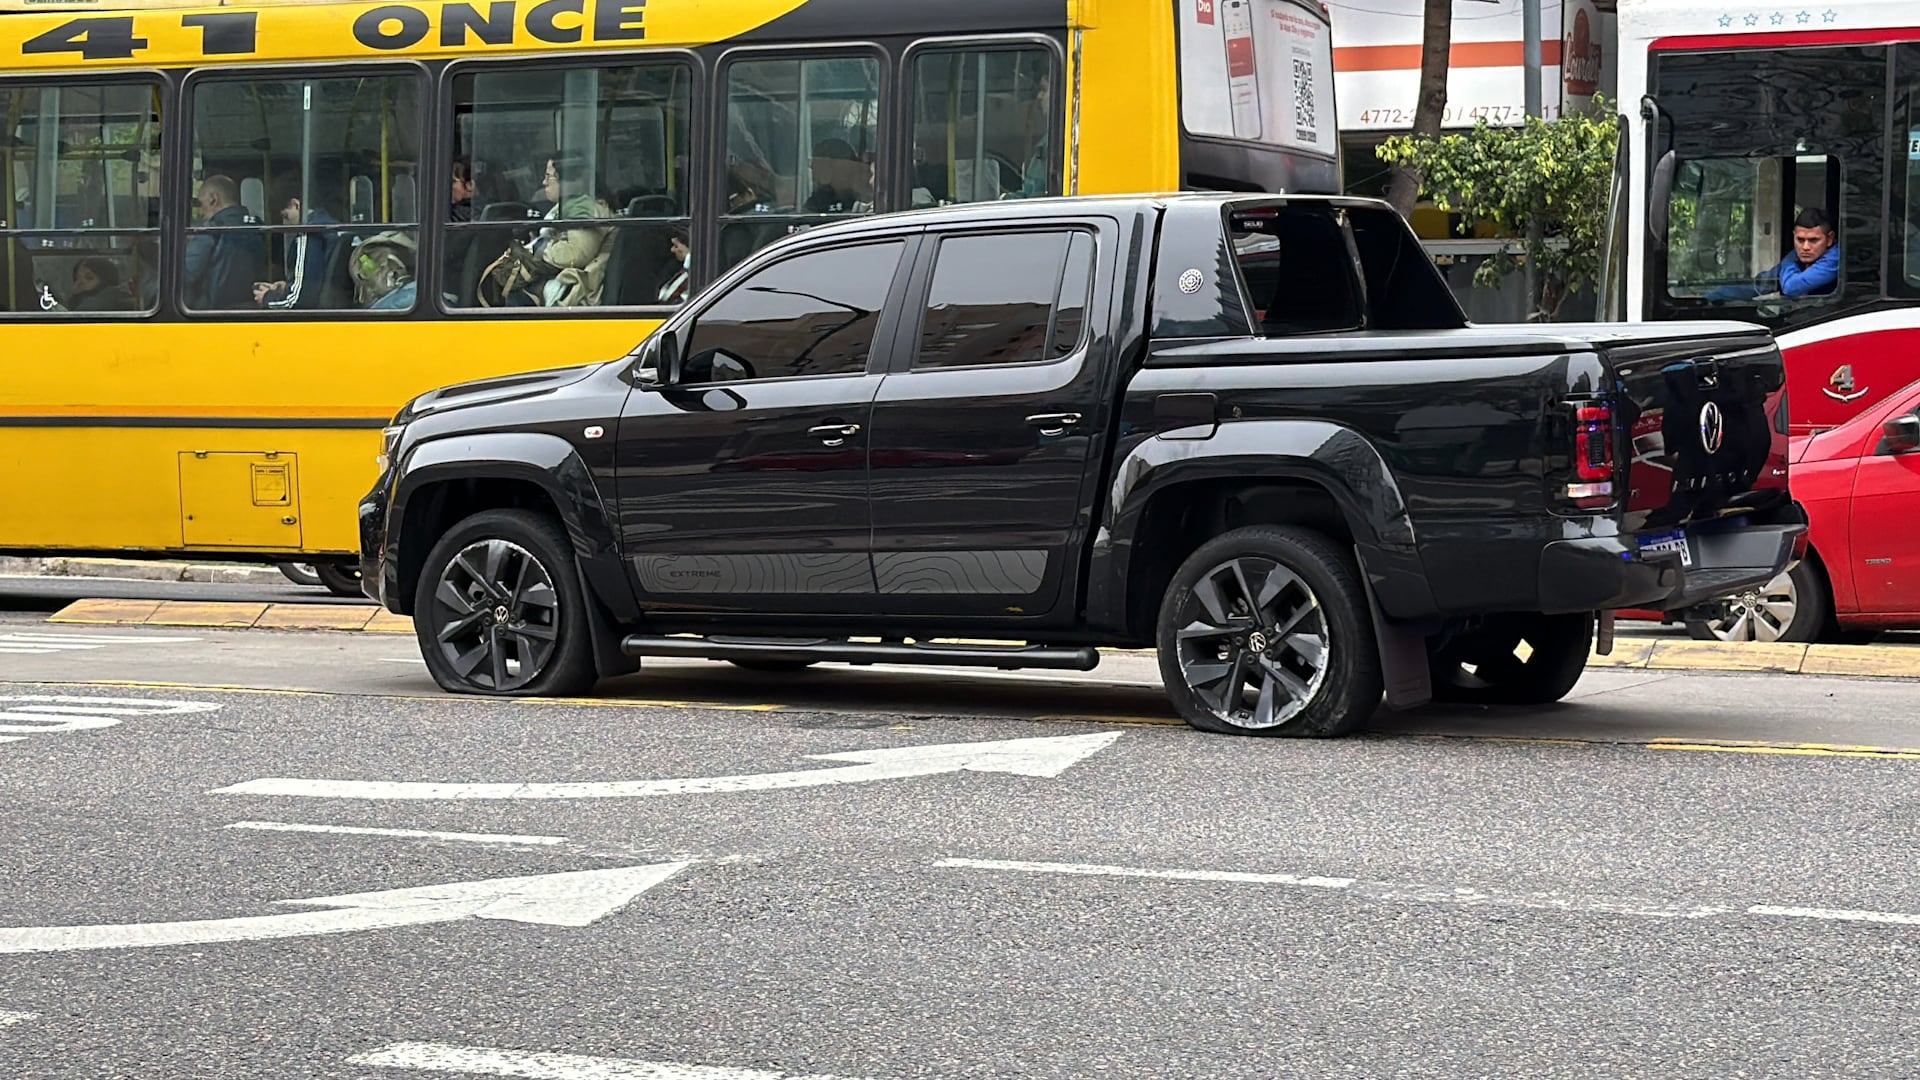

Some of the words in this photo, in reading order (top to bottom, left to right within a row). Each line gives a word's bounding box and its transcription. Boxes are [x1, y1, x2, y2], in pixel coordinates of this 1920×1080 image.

[22, 12, 259, 59] 41
[352, 0, 646, 49] ONCE
[1830, 364, 1854, 391] 4
[670, 570, 721, 578] EXTREME
